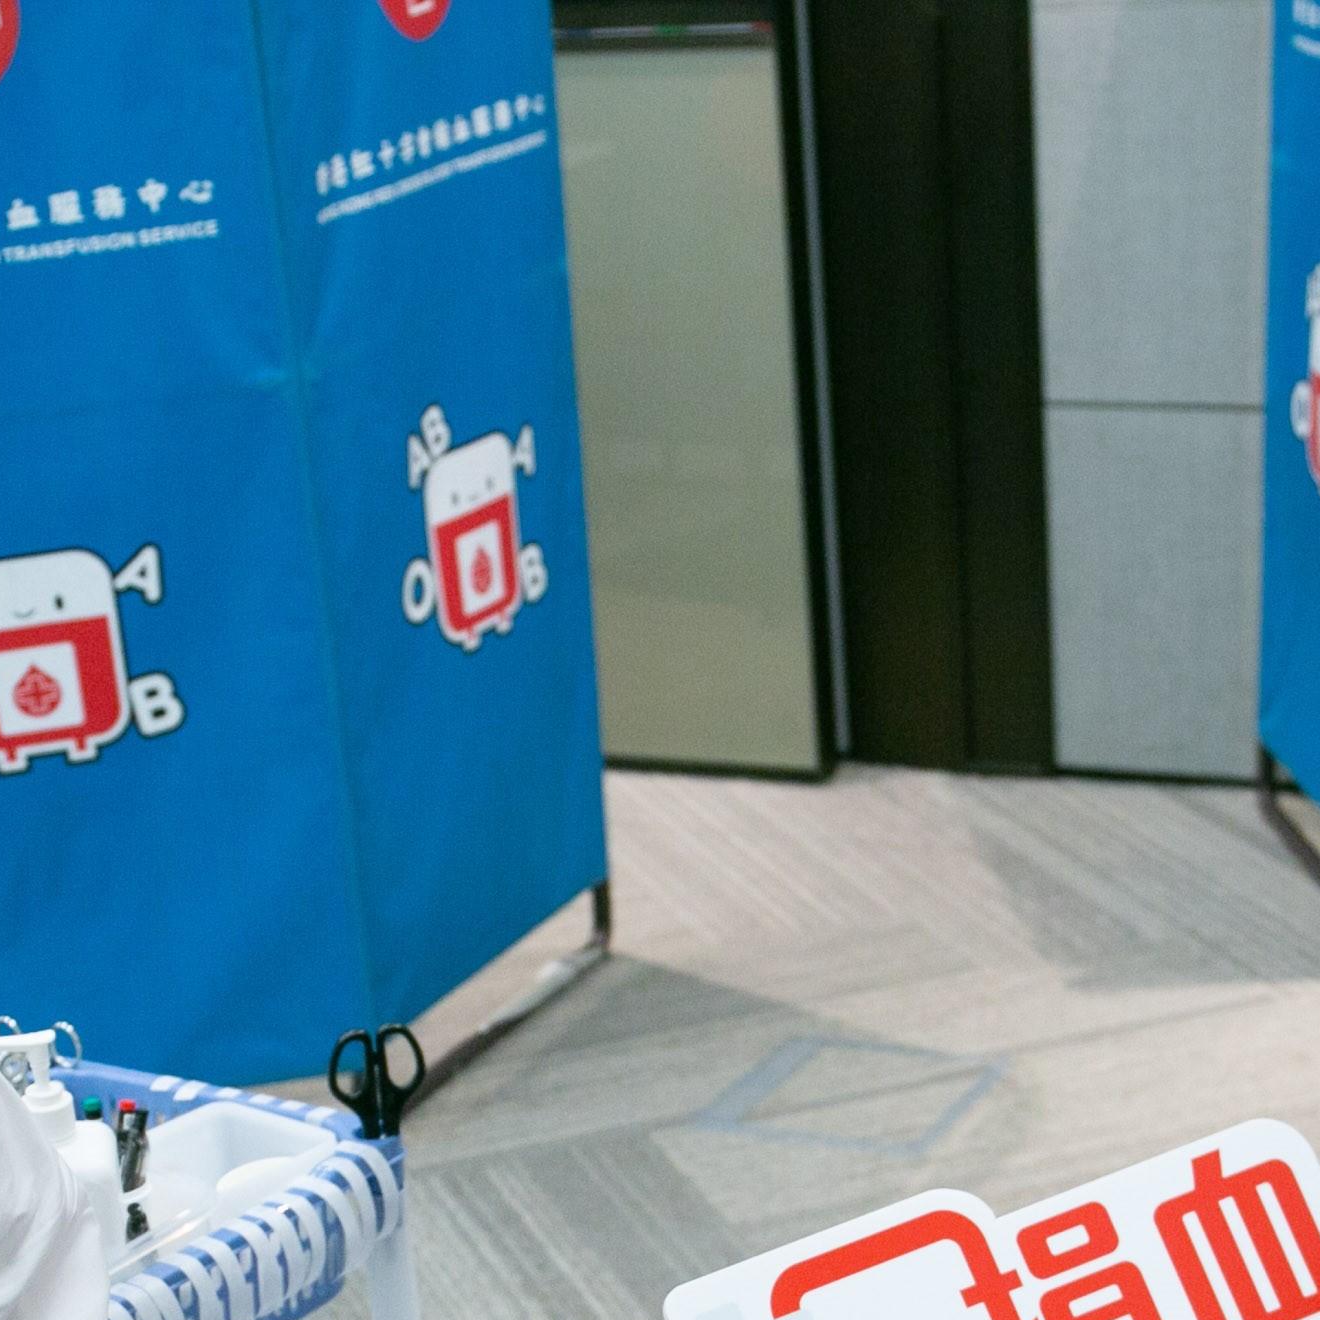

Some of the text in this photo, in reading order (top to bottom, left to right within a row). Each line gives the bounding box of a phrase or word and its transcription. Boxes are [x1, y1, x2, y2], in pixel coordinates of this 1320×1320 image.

[407, 404, 452, 491] AB
[114, 545, 162, 604] A
[402, 558, 434, 624] O
[520, 543, 548, 602] B
[130, 672, 185, 737] B
